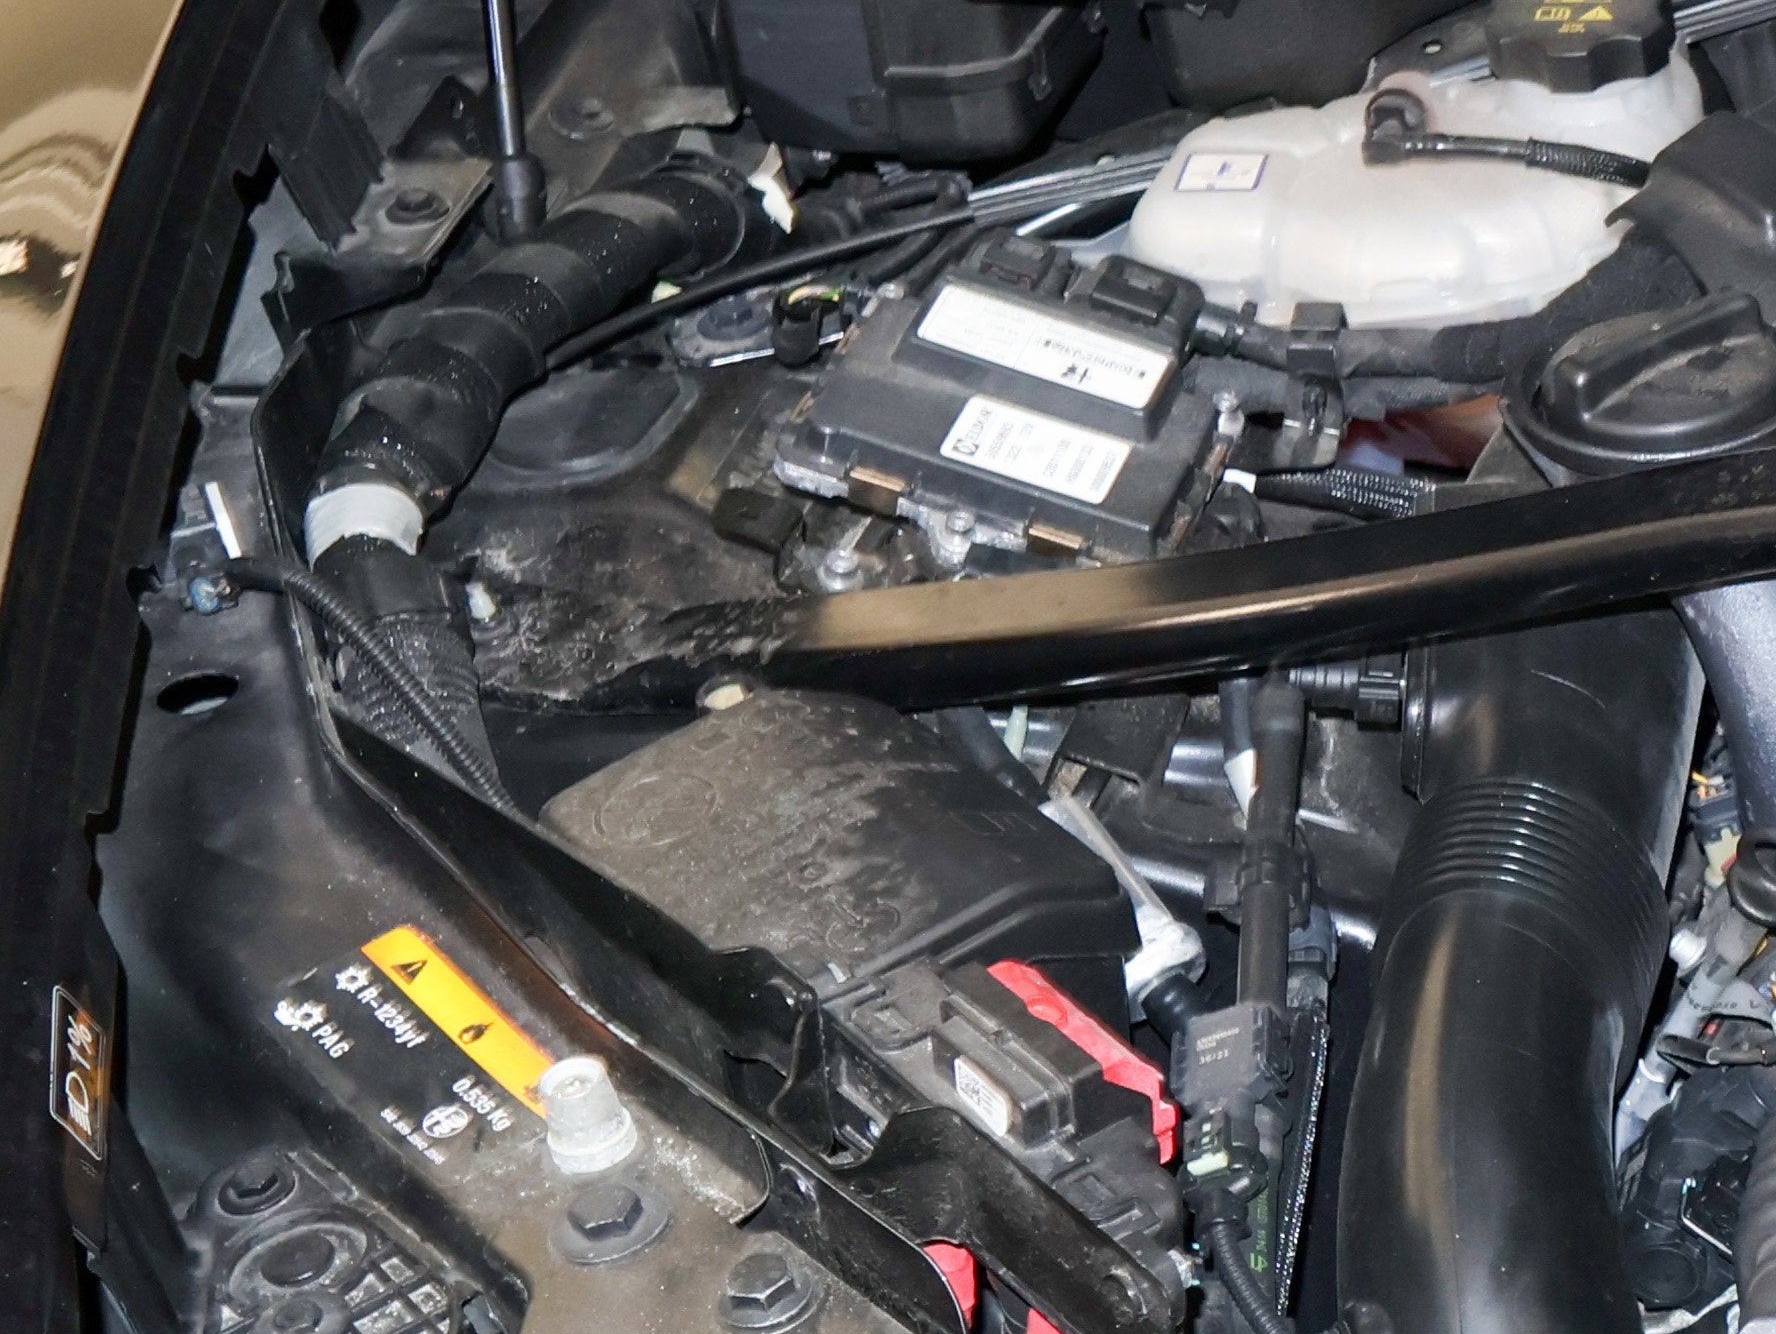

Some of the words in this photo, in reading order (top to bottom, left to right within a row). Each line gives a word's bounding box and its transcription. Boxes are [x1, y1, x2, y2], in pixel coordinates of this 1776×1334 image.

[311, 1023, 351, 1059] PAG
[356, 984, 427, 1048] R-1234yf
[452, 1078, 497, 1115] 0.535
[486, 1107, 512, 1132] Kg
